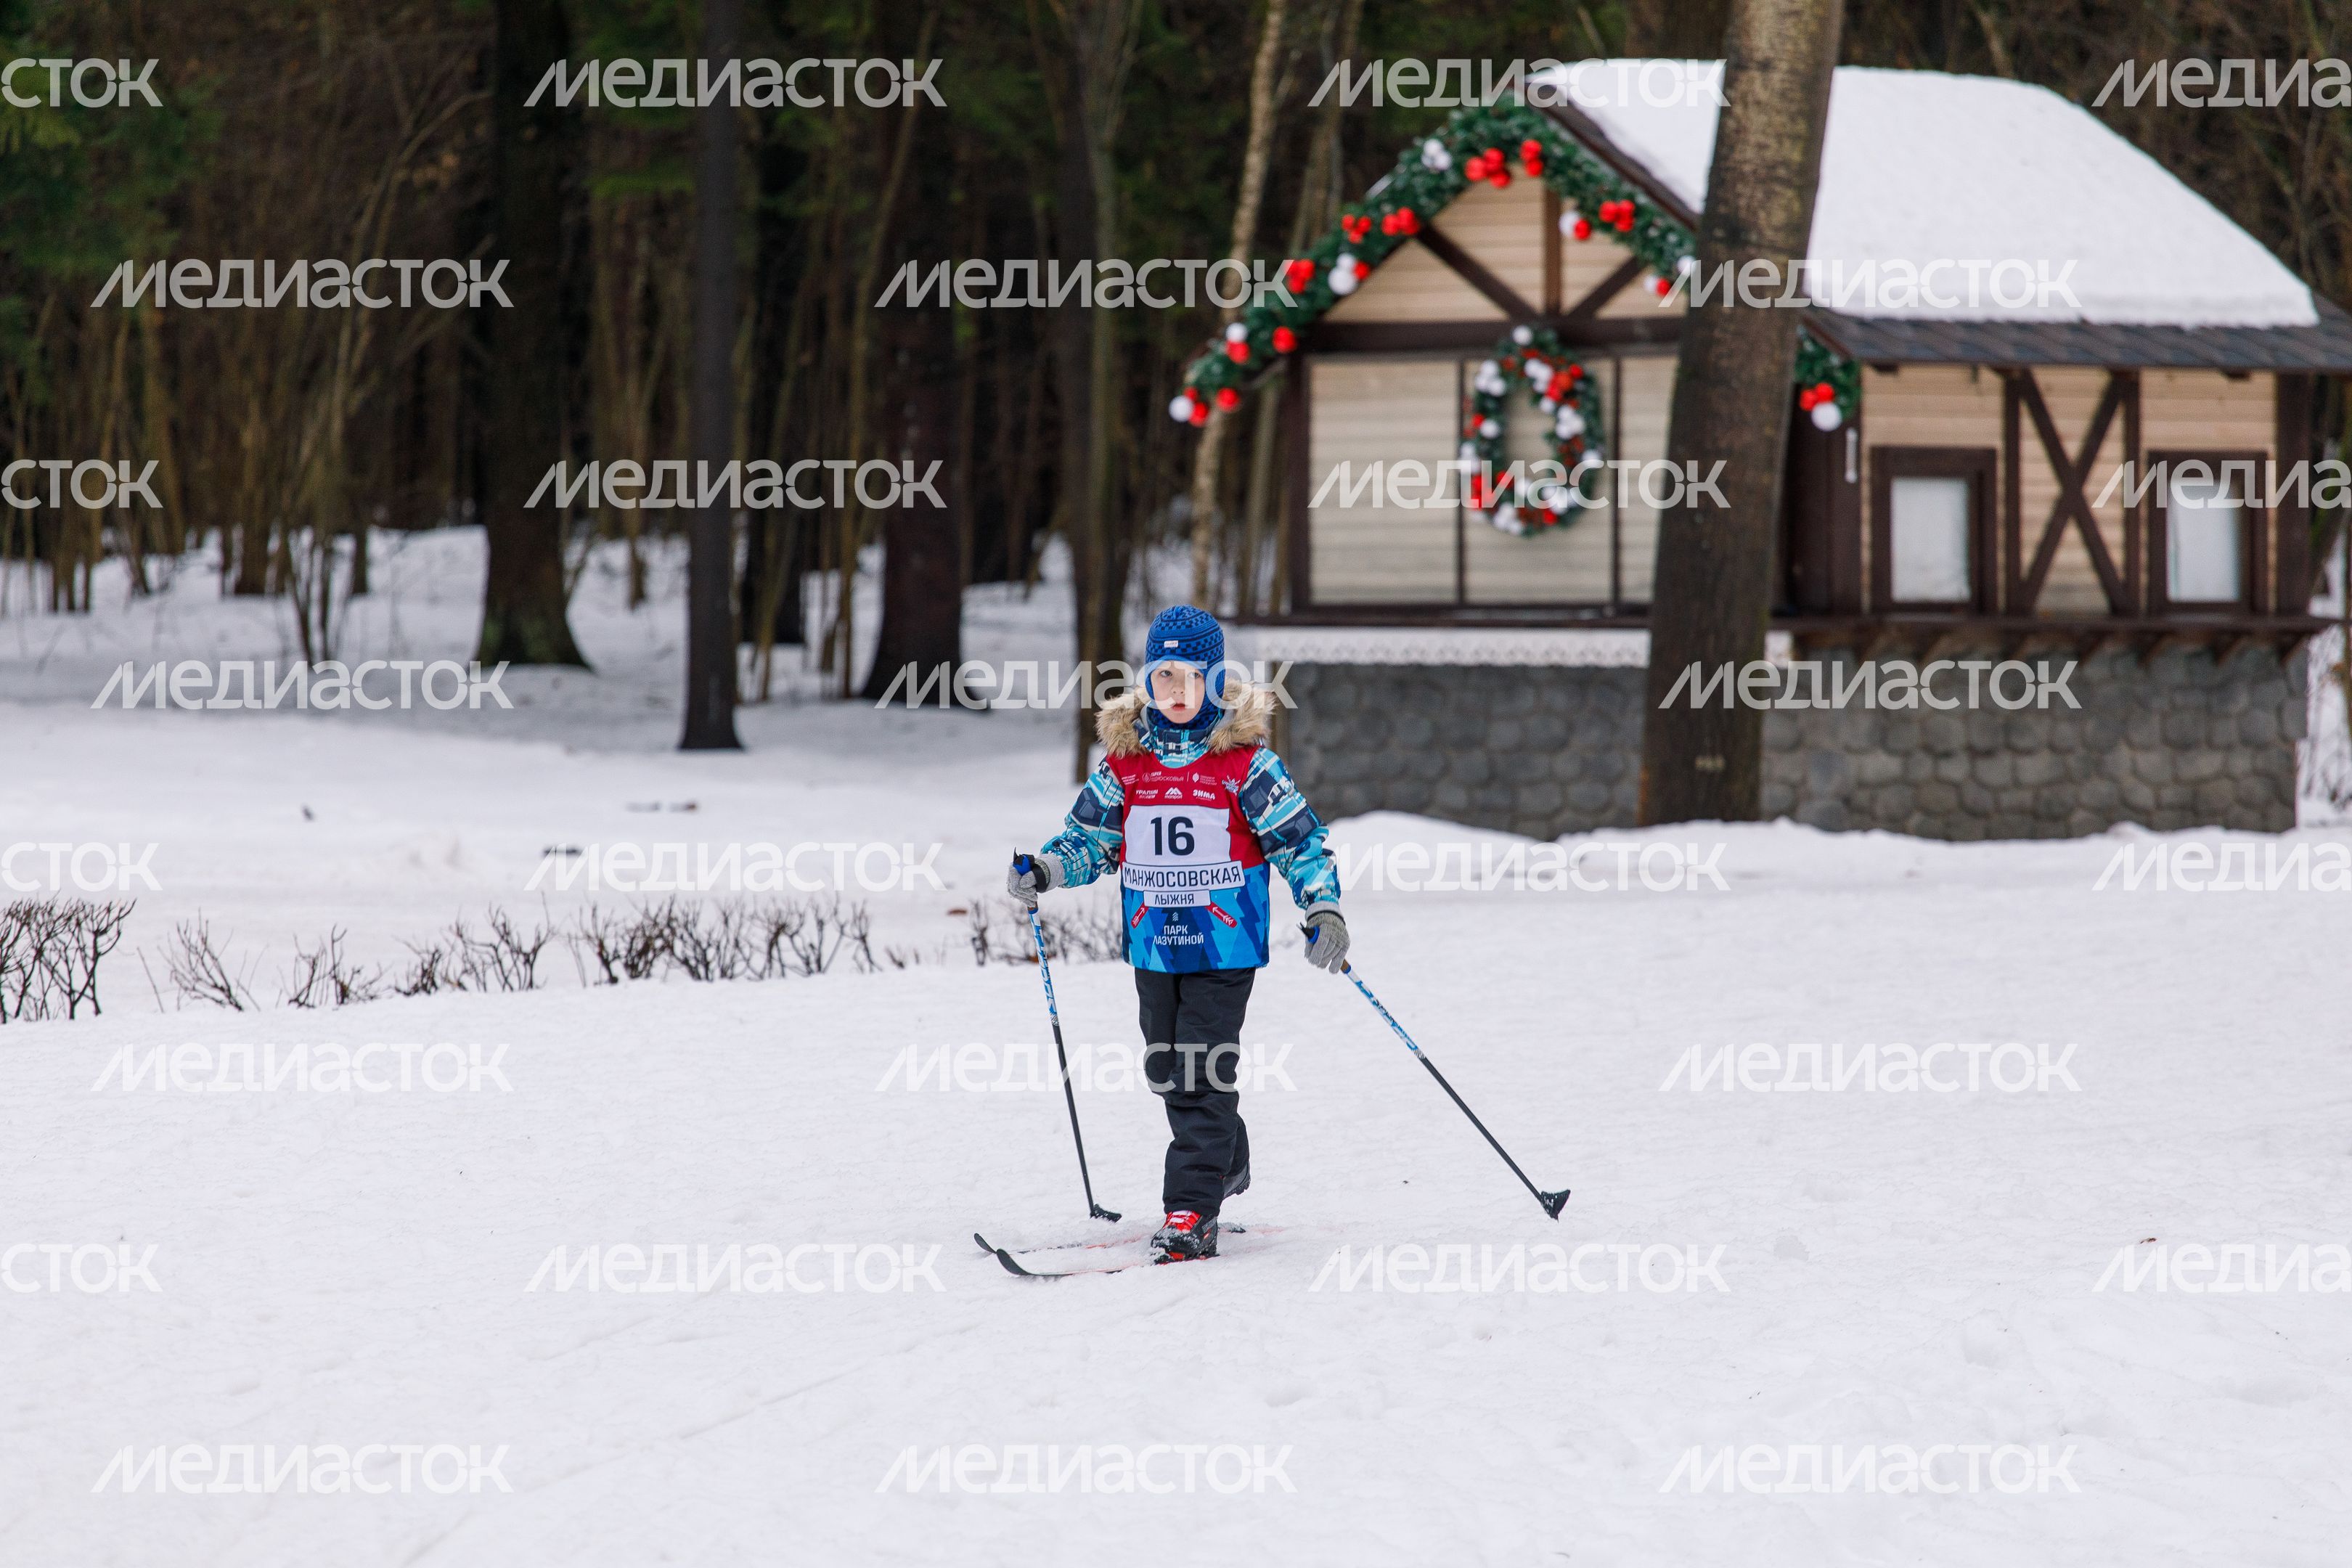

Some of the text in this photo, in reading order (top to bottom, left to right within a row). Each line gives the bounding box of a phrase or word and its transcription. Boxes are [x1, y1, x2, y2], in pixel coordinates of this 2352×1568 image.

[1193, 789, 1216, 800] ЗИМА
[1151, 816, 1195, 856] 16
[1124, 865, 1241, 888] МАНЖОСОВСКАЯ
[1154, 894, 1195, 905] ЛЫЖНЯ
[1163, 925, 1188, 935] ПАРК
[1153, 932, 1204, 946] ЛАЗУТИНОЙ
